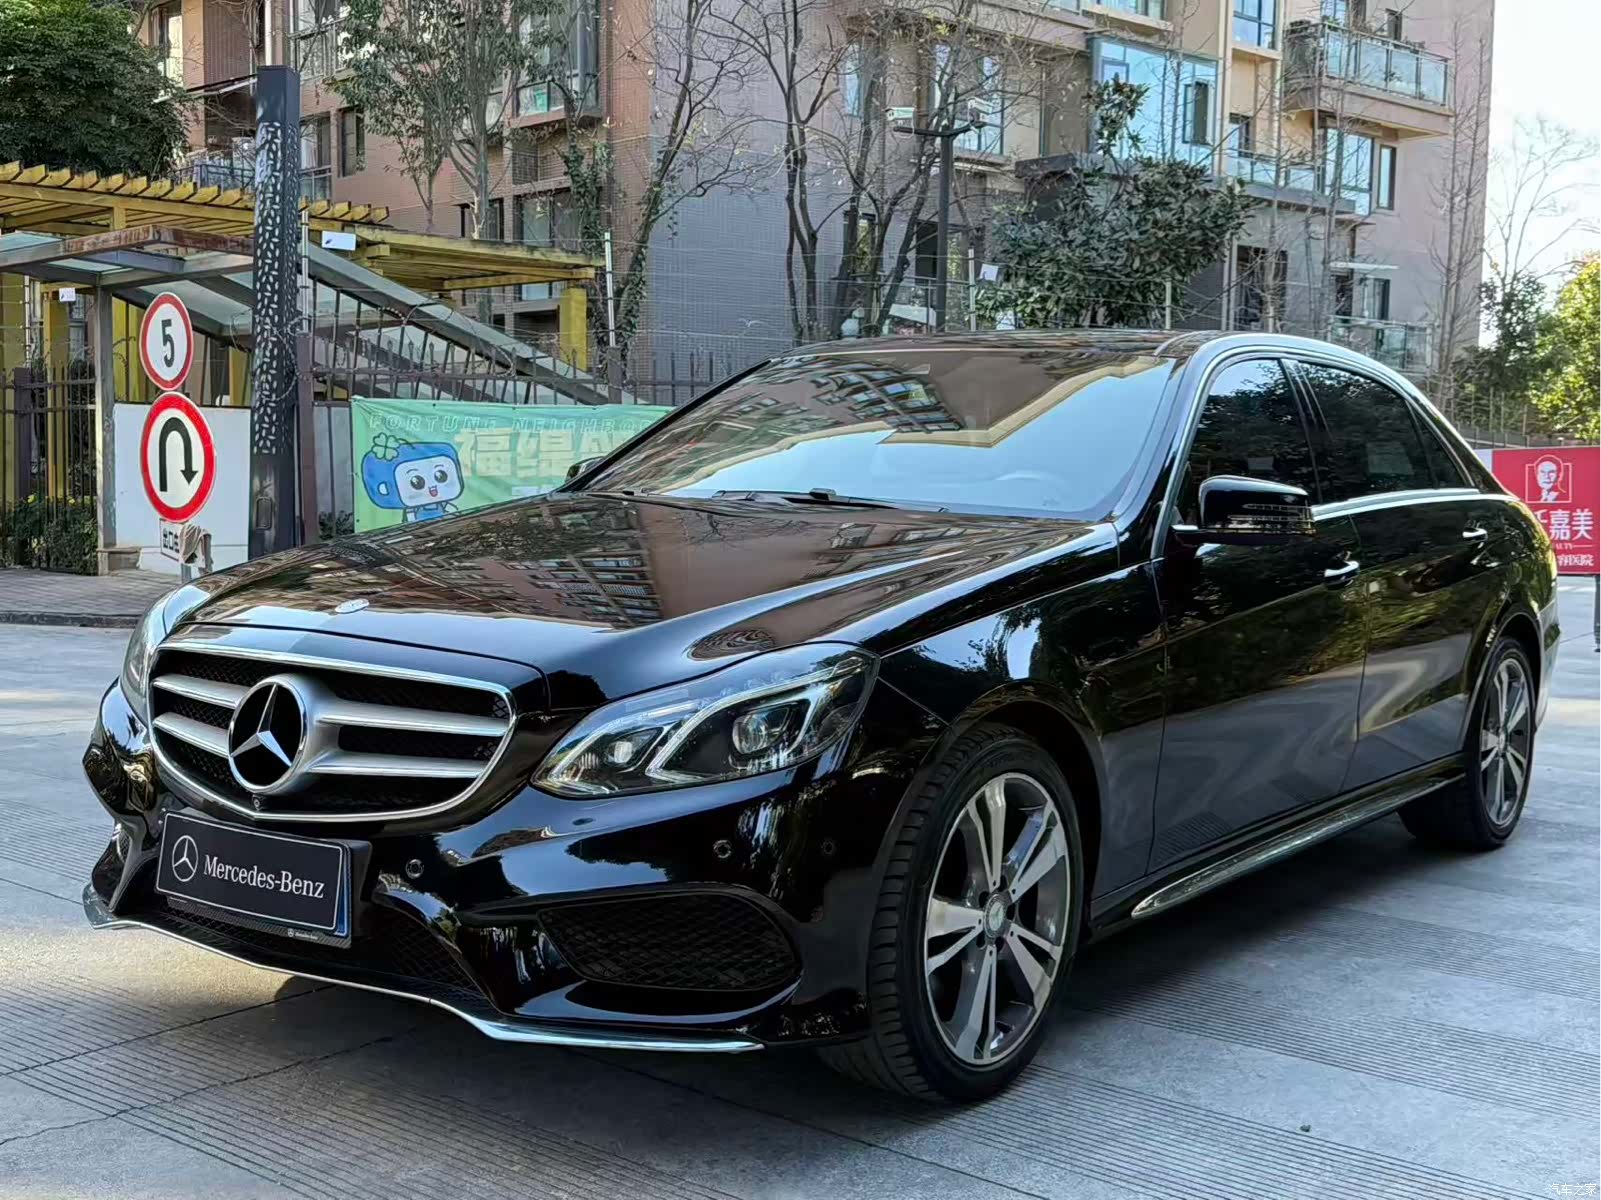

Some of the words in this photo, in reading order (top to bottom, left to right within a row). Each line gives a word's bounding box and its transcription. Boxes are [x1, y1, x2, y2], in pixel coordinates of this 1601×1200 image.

[161, 319, 175, 368] 5
[369, 413, 497, 432] FORTUNE
[203, 854, 325, 899] Mercedes-Benz
